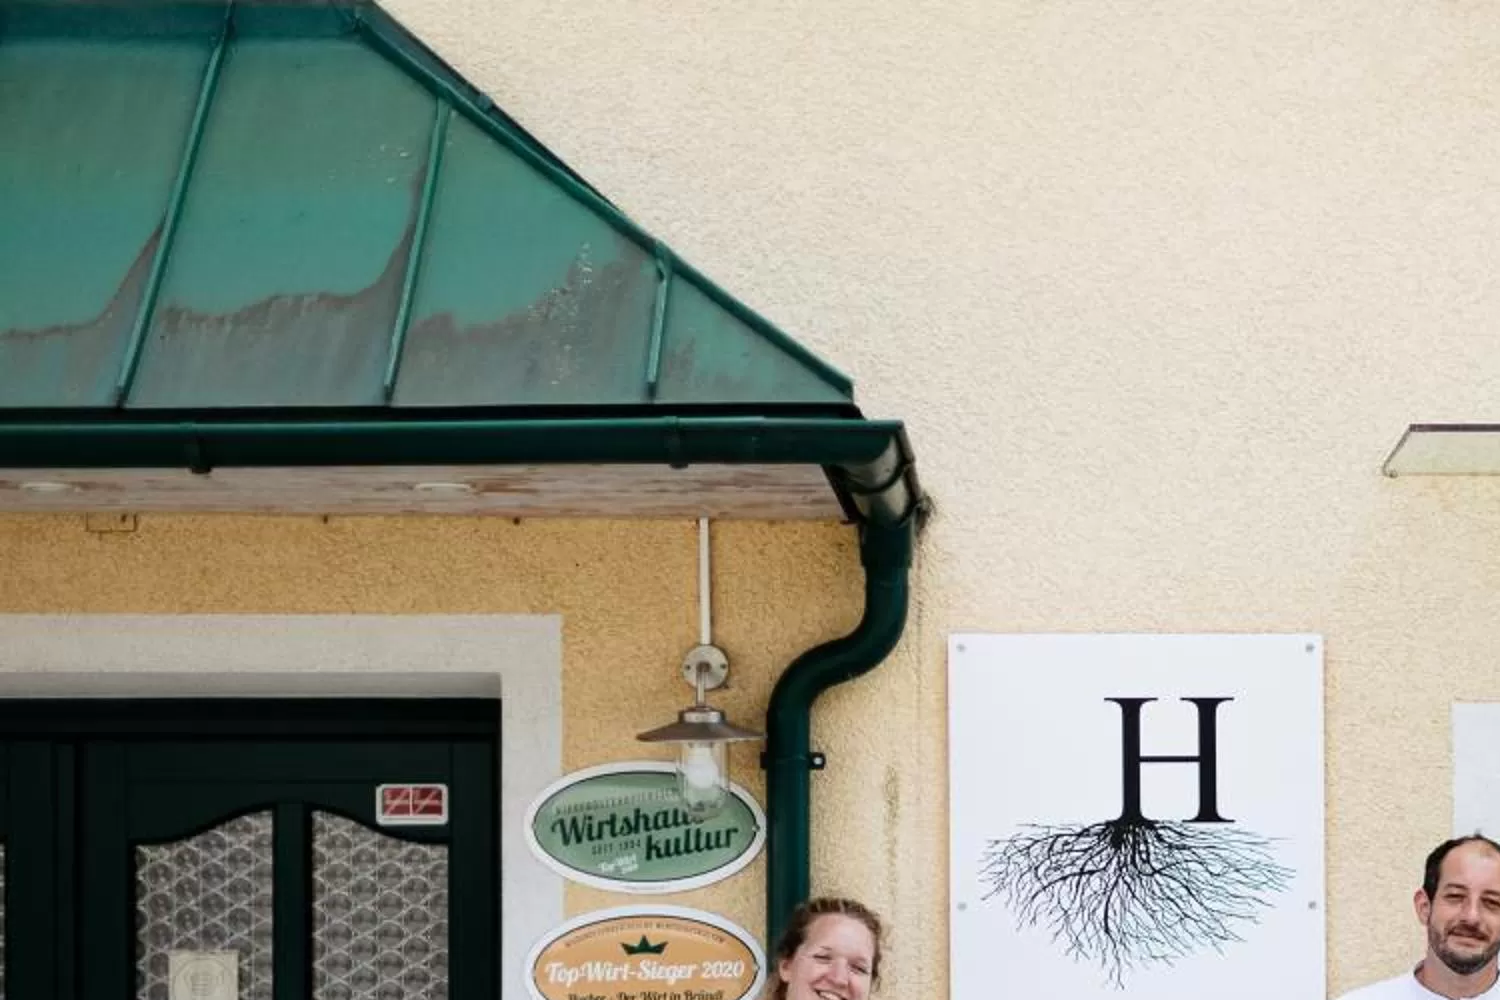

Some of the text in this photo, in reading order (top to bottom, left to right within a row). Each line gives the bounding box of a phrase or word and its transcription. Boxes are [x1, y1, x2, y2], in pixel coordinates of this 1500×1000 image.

[1104, 697, 1236, 823] H
[645, 827, 739, 861] kultur
[701, 960, 745, 979] 2020
